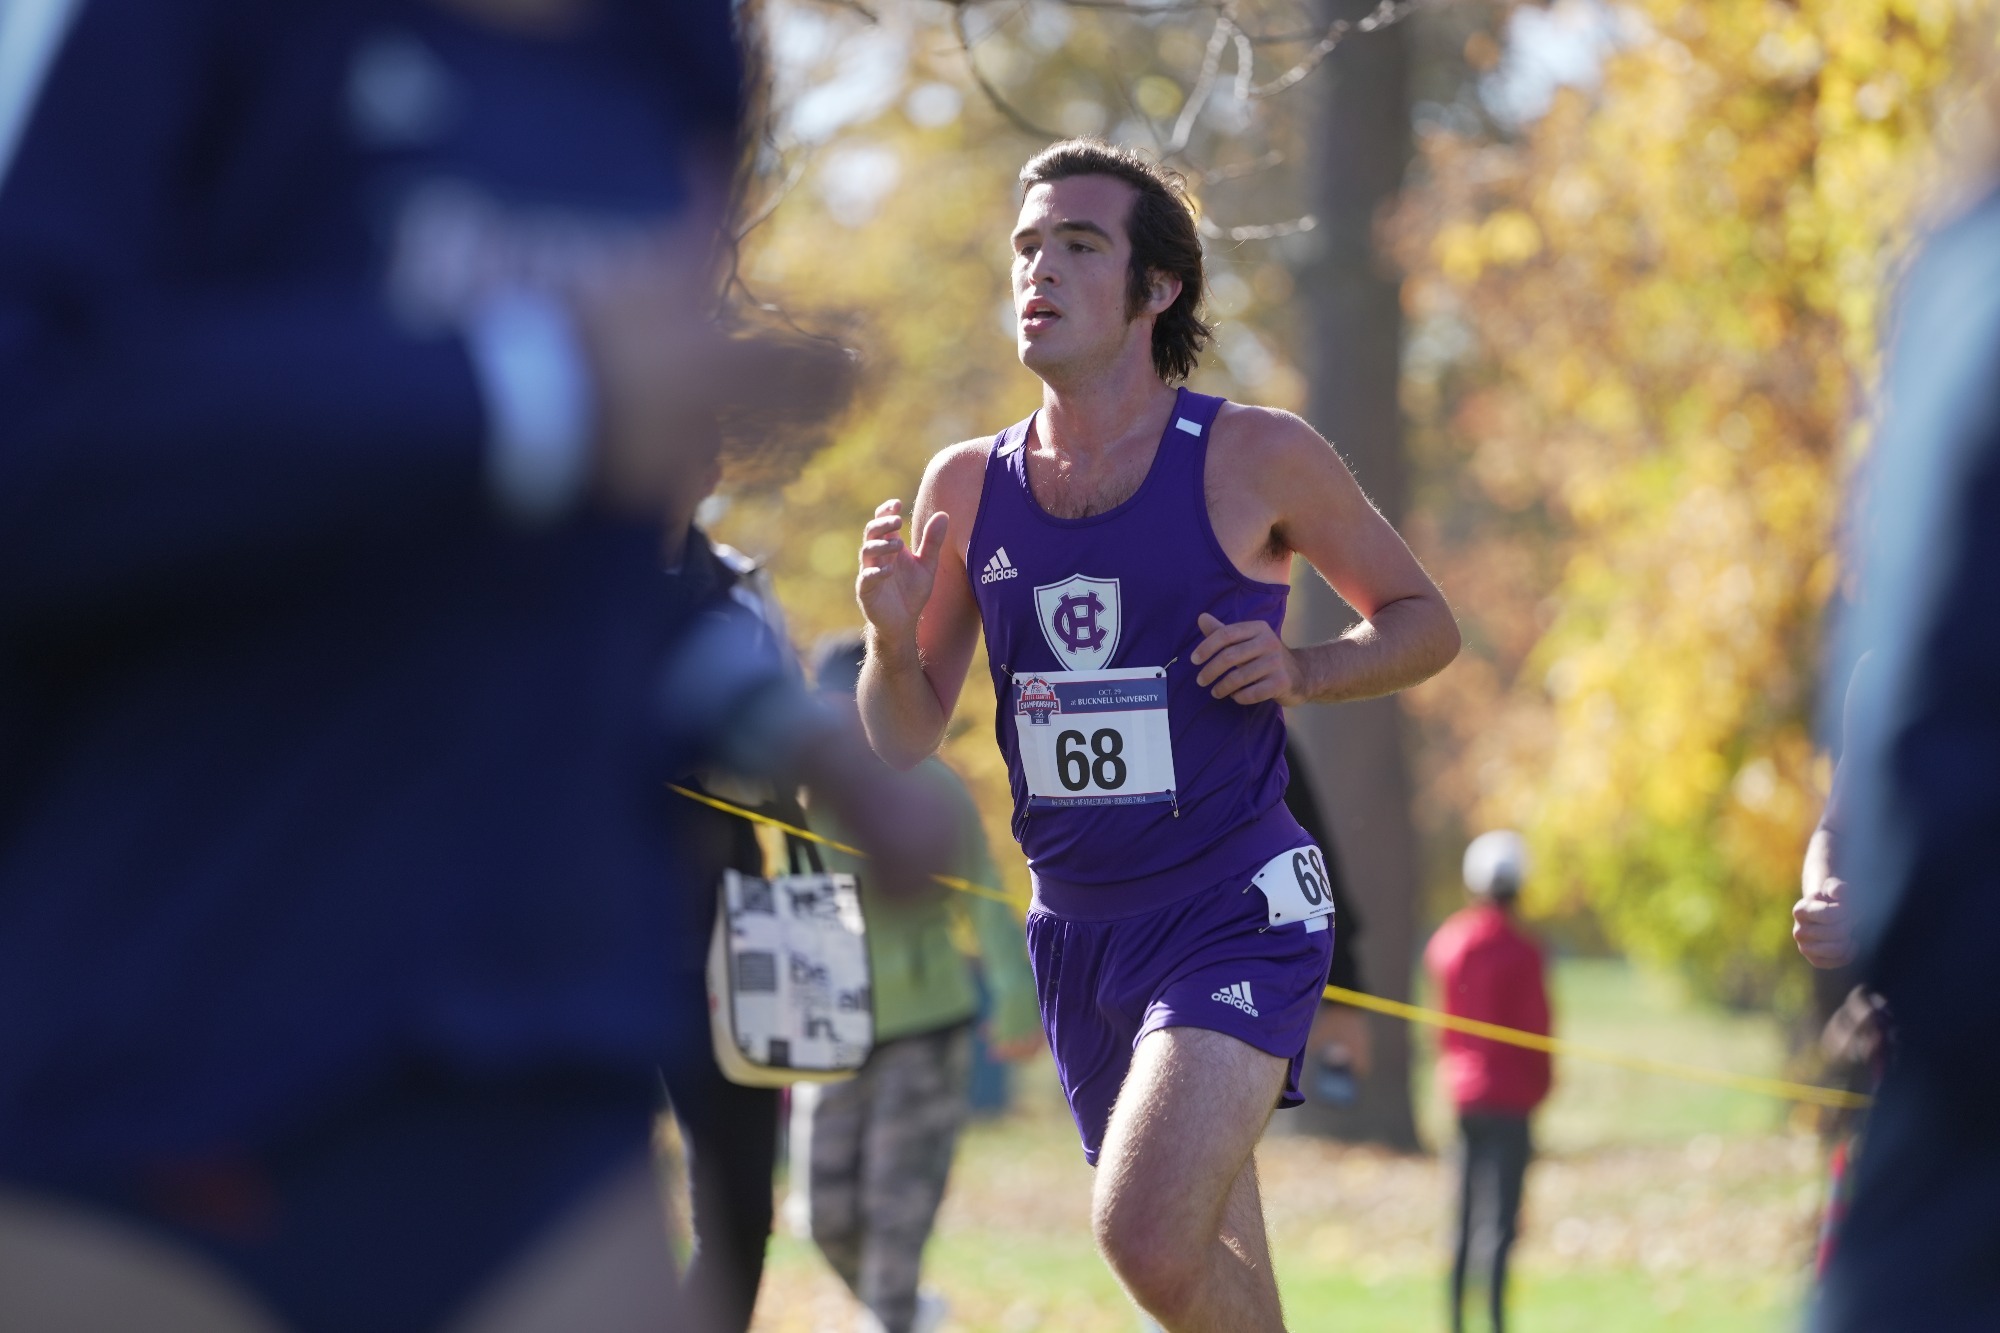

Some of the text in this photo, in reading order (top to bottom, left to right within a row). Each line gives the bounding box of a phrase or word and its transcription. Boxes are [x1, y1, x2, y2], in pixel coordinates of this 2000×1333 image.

[981, 567, 1018, 584] adidas
[1020, 701, 1058, 710] CHAMPIONSHIPS
[1077, 696, 1114, 706] BUCKNELL
[1115, 694, 1159, 704] UNIVERSITY
[1056, 728, 1127, 791] 68
[1292, 849, 1332, 905] 68
[1211, 992, 1259, 1018] adidas
